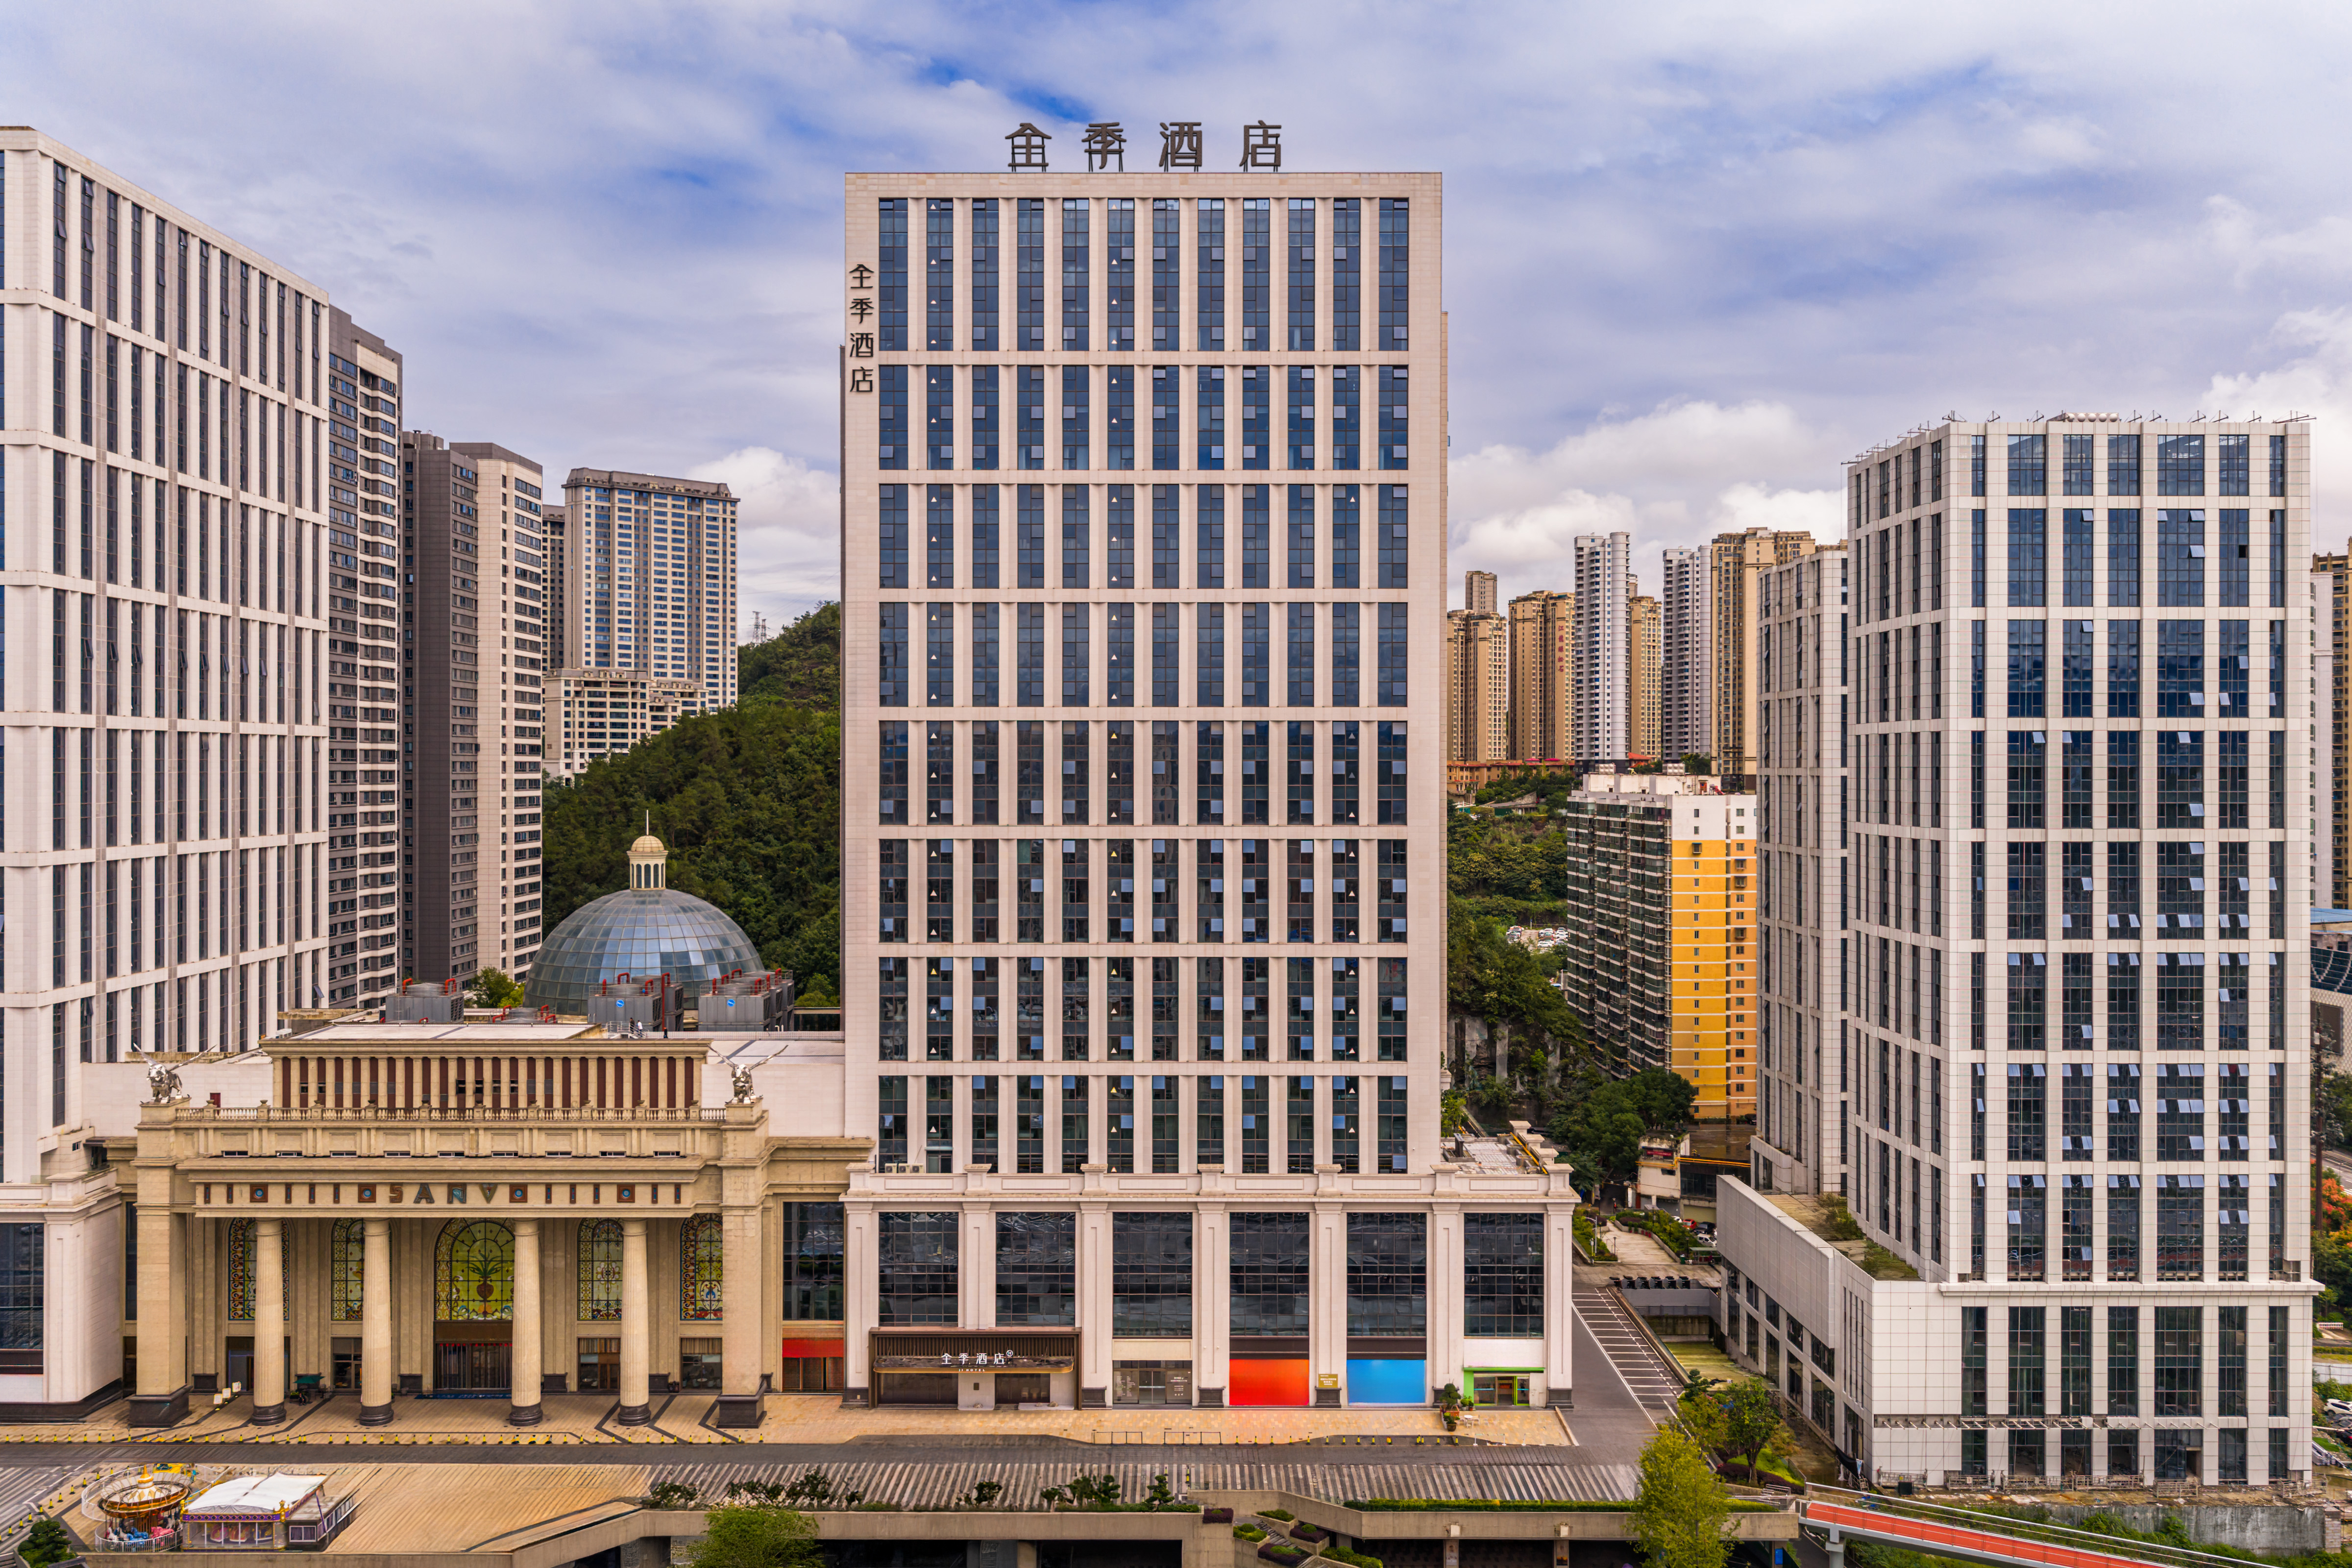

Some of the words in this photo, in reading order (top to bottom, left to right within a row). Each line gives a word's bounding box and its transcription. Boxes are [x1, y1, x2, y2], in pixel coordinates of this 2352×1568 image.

[1005, 120, 1282, 169] 全季酒店
[849, 264, 874, 392] 全季酒店
[941, 1353, 1004, 1365] 全季酒店
